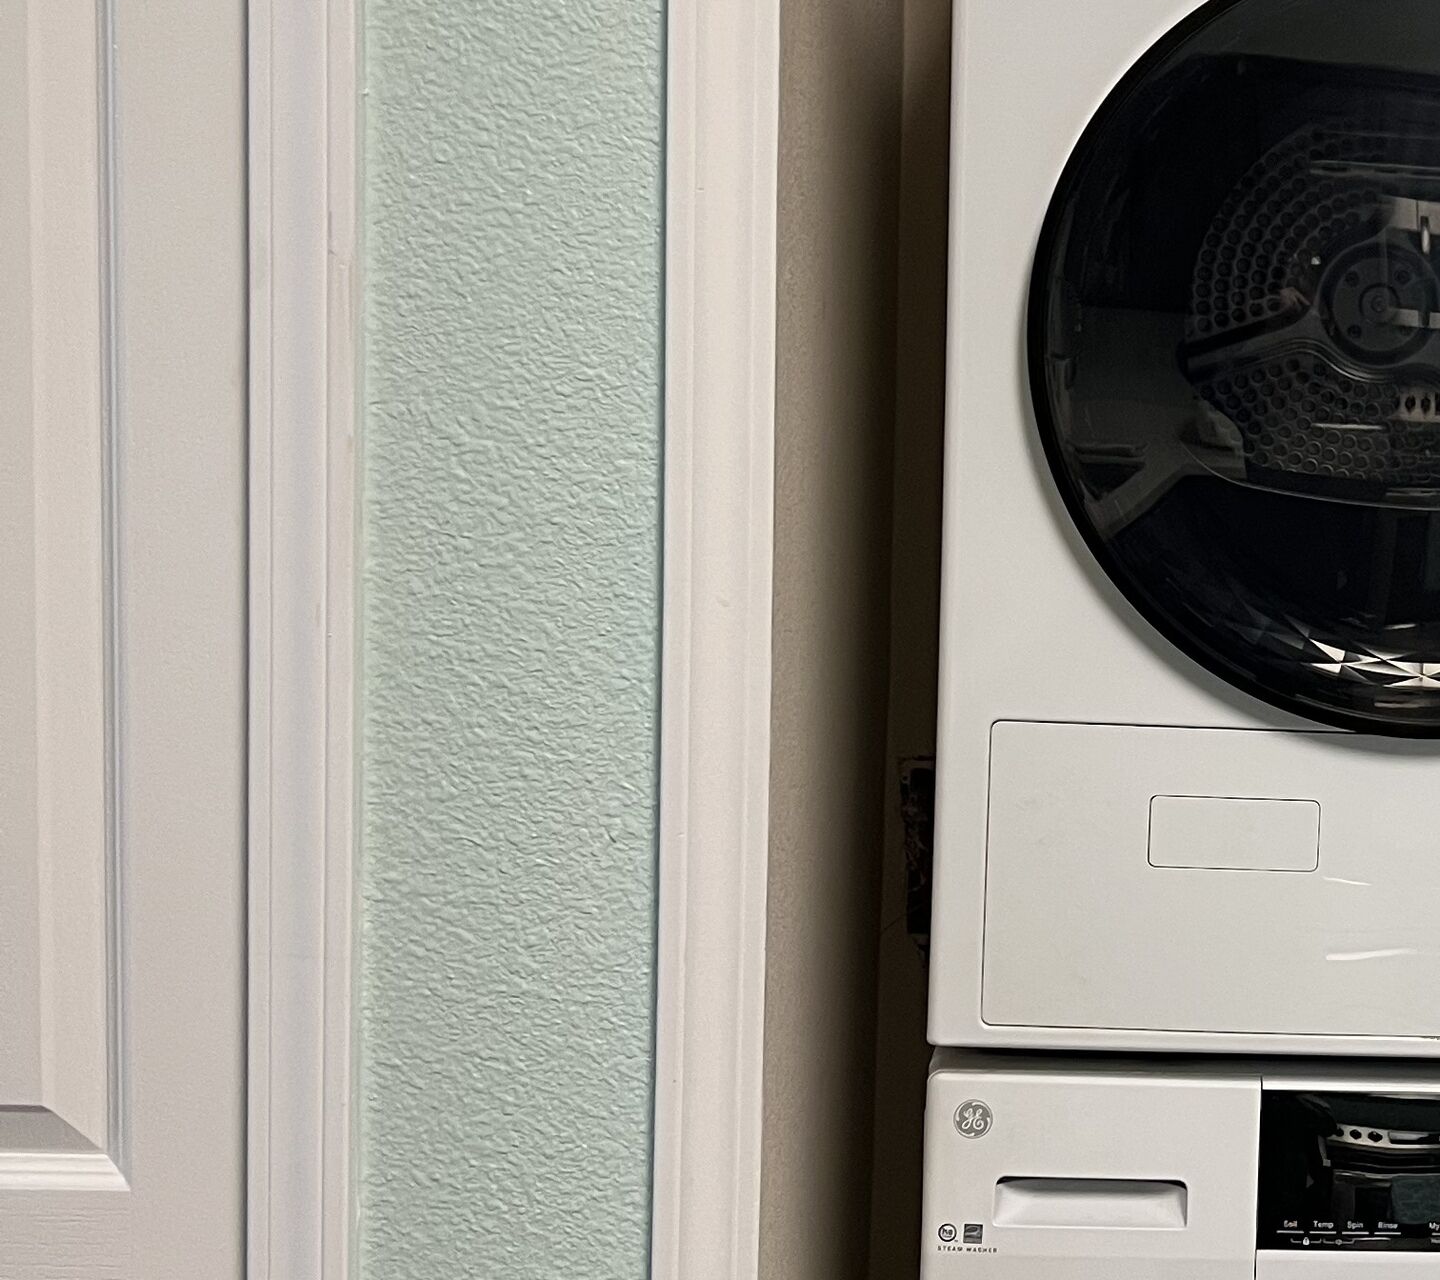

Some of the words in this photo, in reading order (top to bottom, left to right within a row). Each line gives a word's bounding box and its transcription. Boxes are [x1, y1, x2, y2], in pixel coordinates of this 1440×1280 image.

[1313, 1220, 1334, 1229] Temp
[1347, 1221, 1363, 1230] Spin
[1378, 1221, 1398, 1229] Rinse
